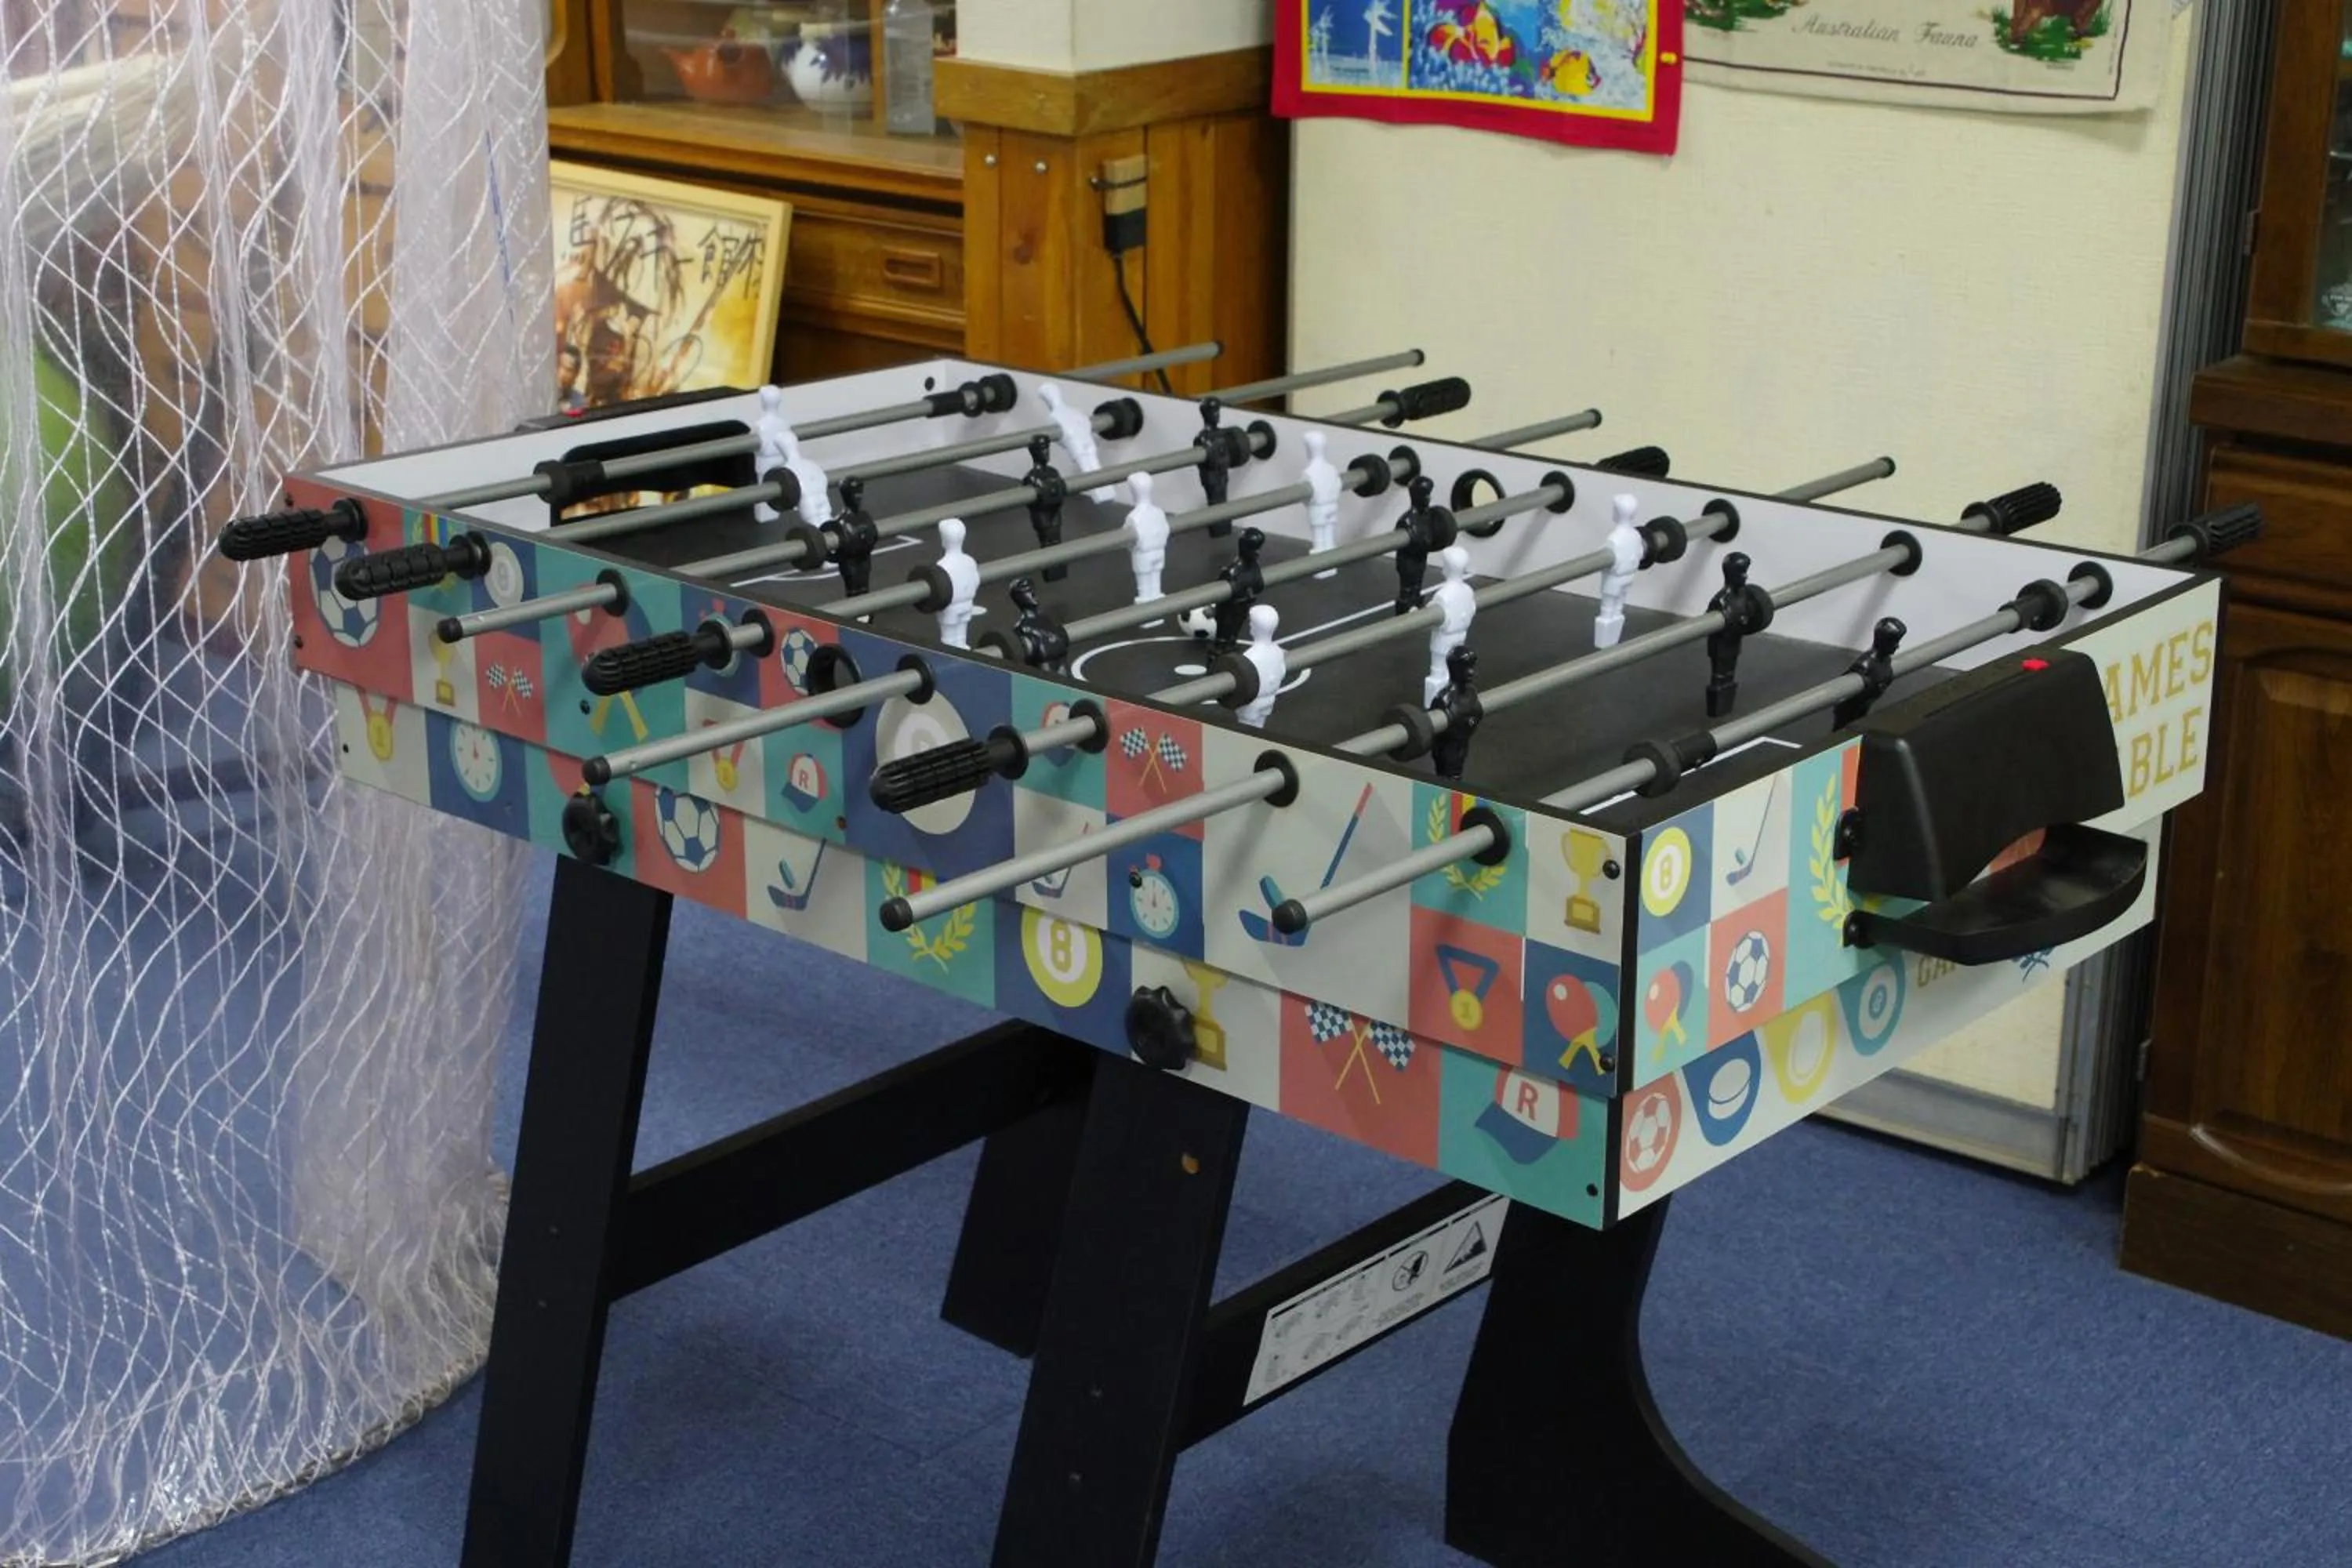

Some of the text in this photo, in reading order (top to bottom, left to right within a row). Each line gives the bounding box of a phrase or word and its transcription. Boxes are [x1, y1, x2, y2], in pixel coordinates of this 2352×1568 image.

[1791, 13, 1980, 48] Australian Fauna
[2105, 618, 2215, 724] AMES
[2127, 706, 2203, 799] BLE
[1050, 918, 1072, 973] 8
[1517, 1080, 1538, 1122] R
